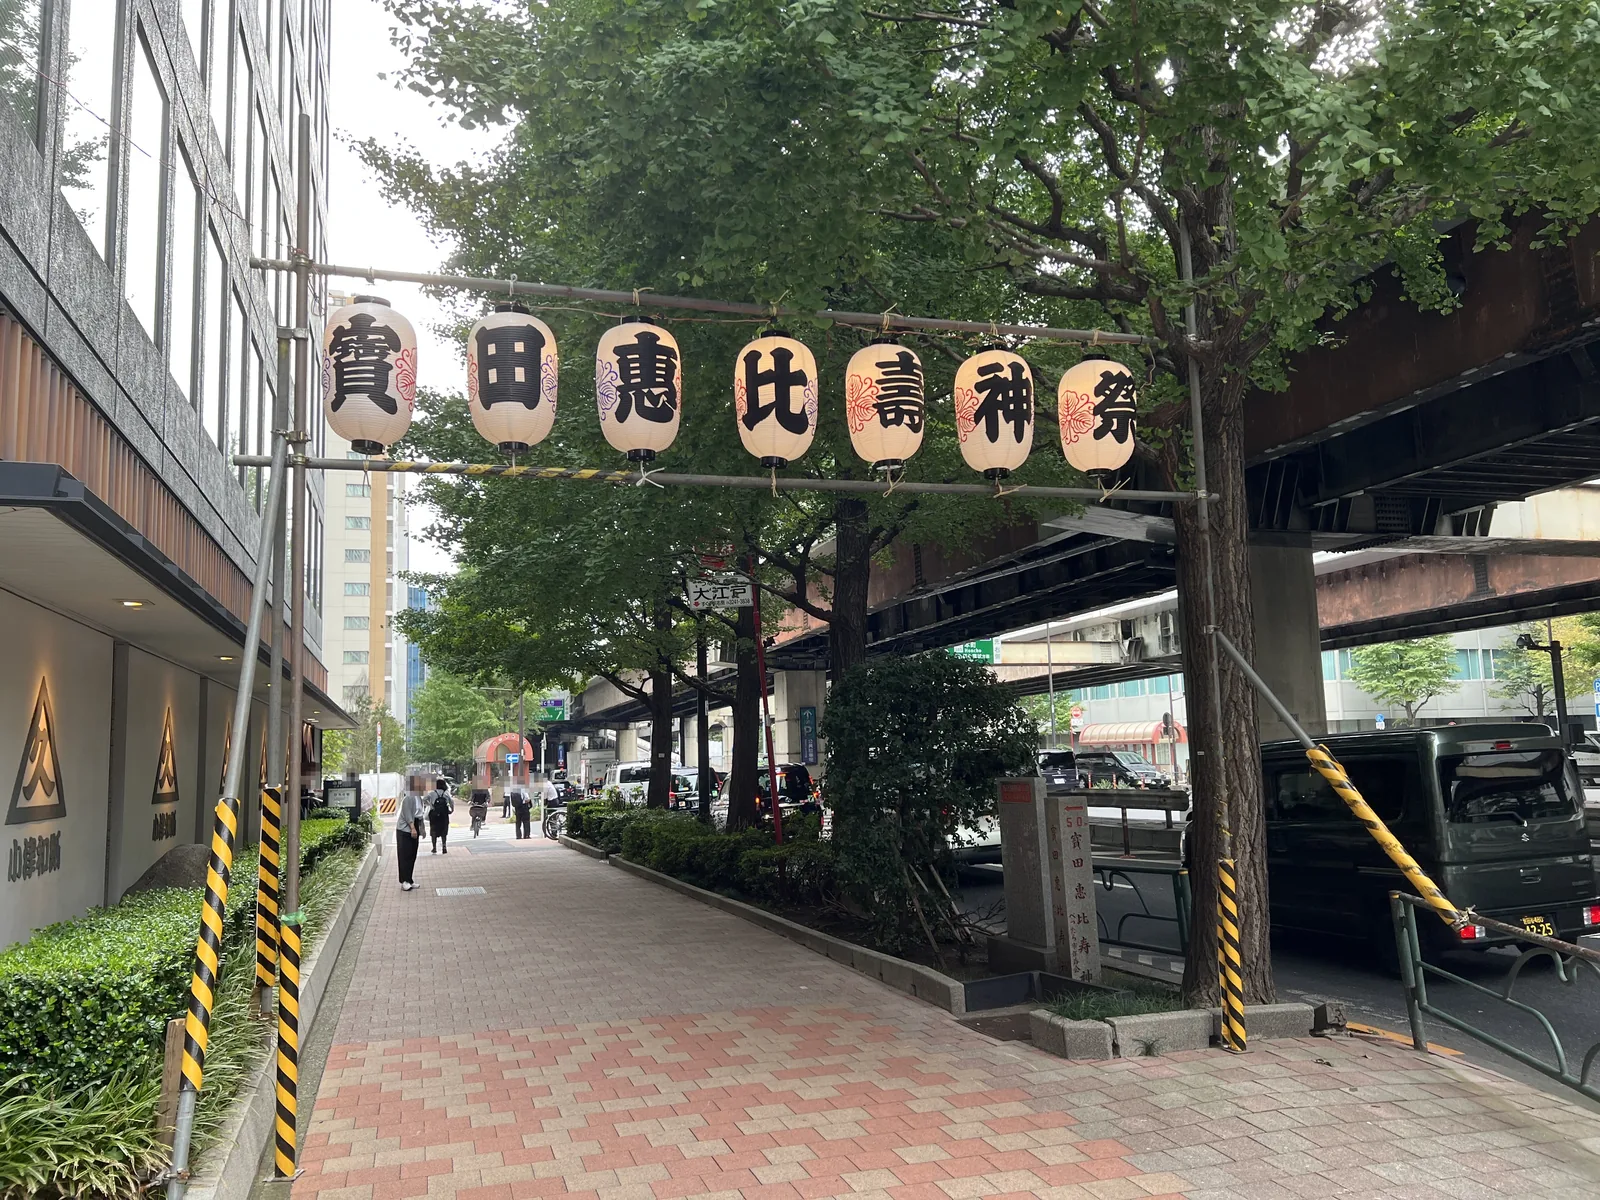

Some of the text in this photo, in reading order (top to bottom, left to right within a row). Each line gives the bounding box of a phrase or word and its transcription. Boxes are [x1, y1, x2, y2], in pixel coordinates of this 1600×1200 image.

[475, 324, 546, 411] 田
[742, 347, 808, 434] 比
[973, 361, 1032, 444] 神
[1092, 370, 1136, 445] 祭
[693, 585, 747, 601] 大江戸
[803, 725, 812, 737] P
